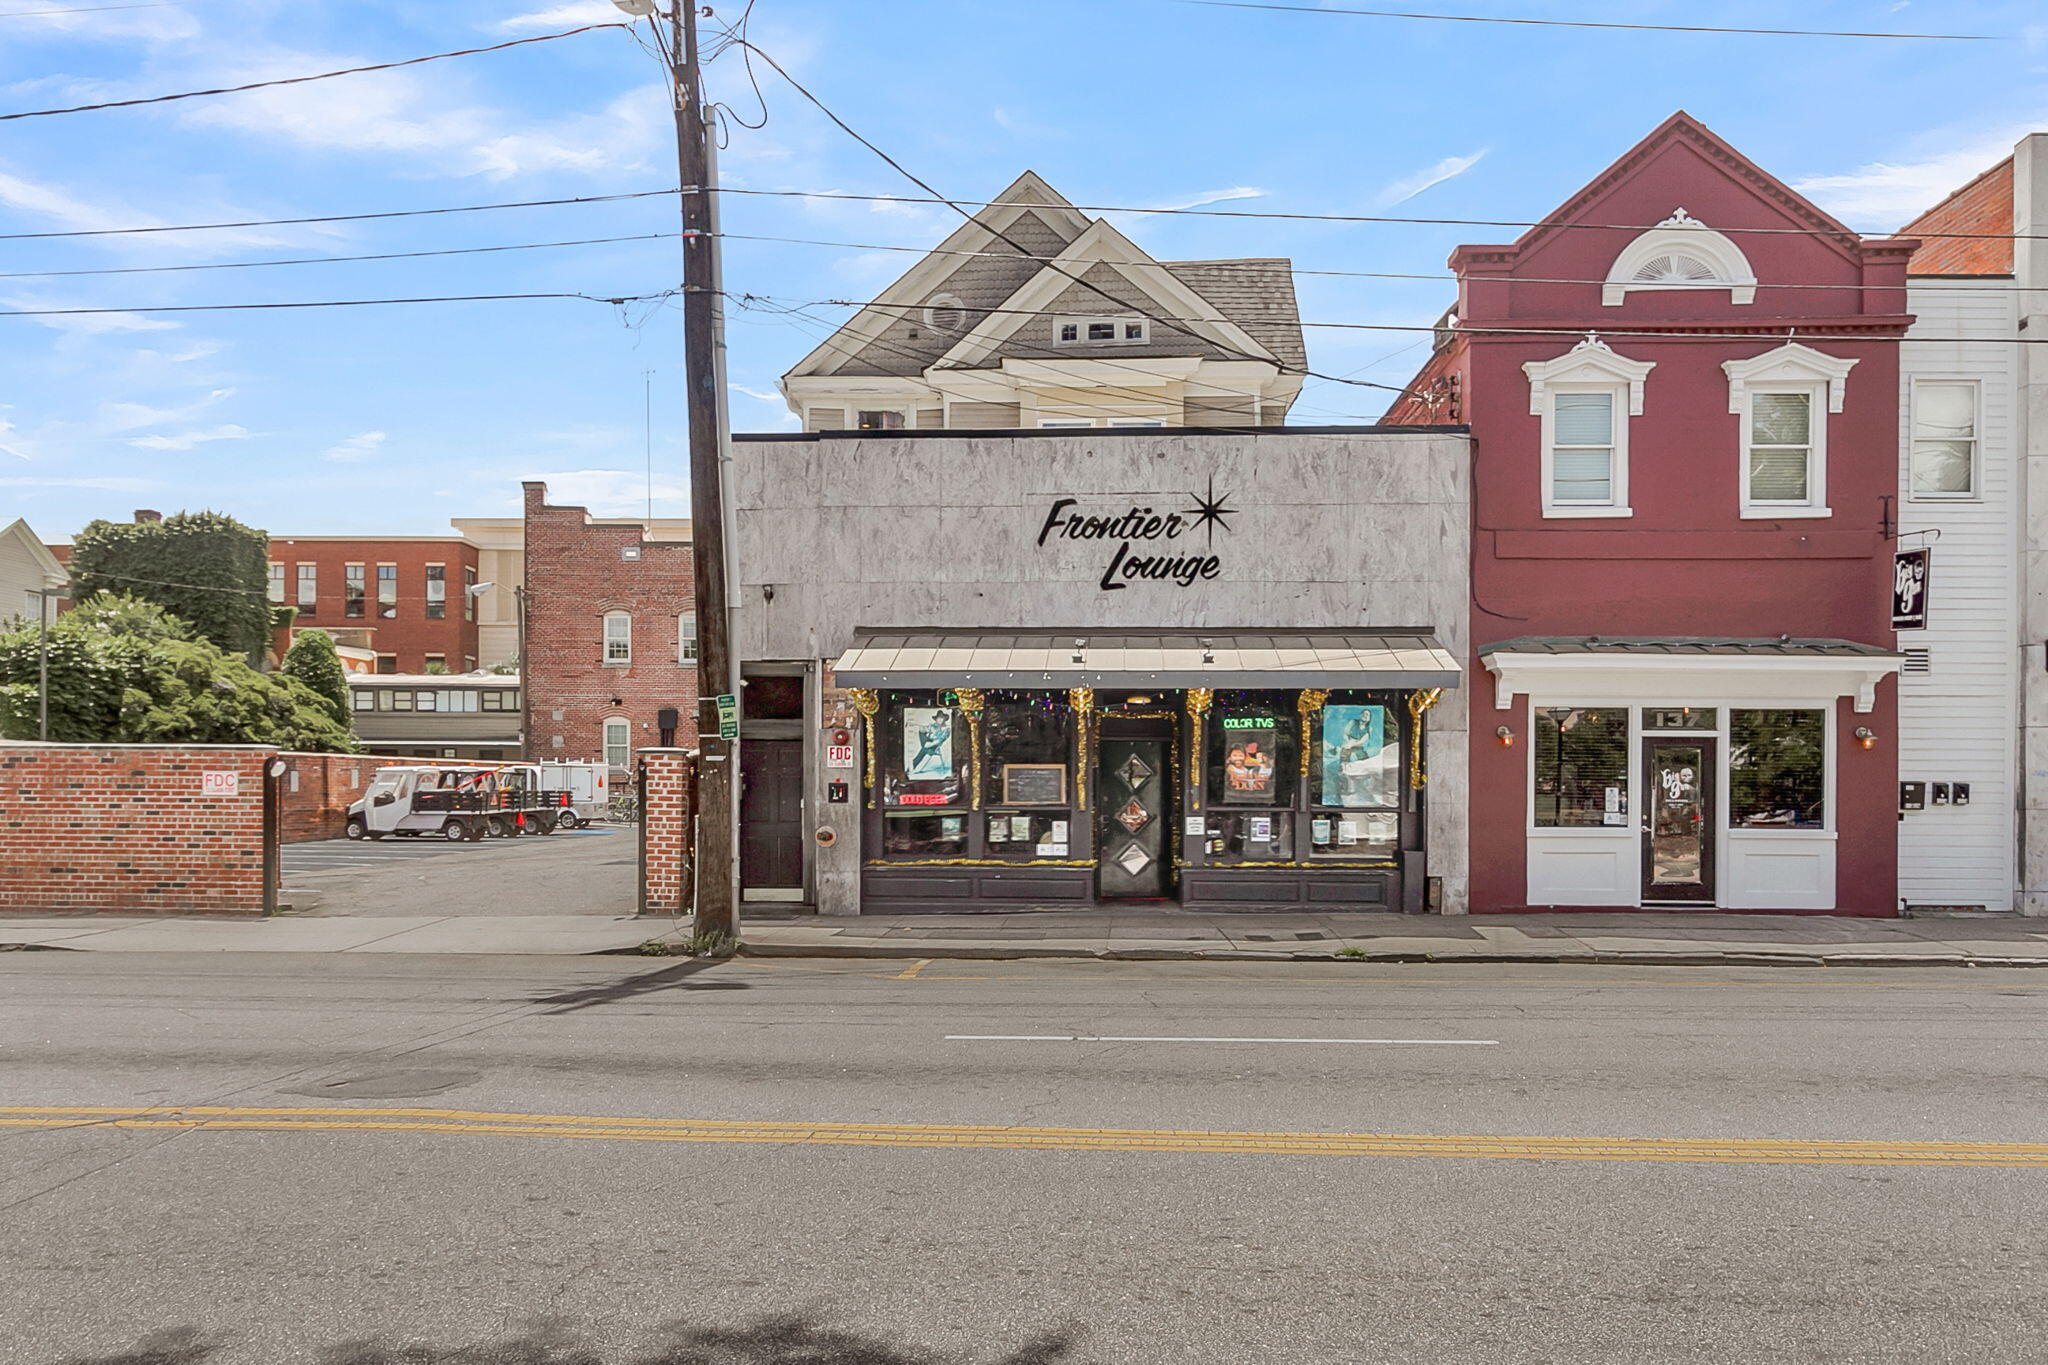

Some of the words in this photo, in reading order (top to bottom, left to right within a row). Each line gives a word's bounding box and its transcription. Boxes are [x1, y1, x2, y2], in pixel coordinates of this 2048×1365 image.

[1037, 498, 1183, 547] Frontier
[1100, 541, 1220, 590] Lounge
[1223, 718, 1253, 729] COLOR
[1255, 717, 1275, 728] TVS
[1656, 712, 1700, 727] 137
[829, 747, 851, 760] FDC
[205, 774, 235, 787] FDC
